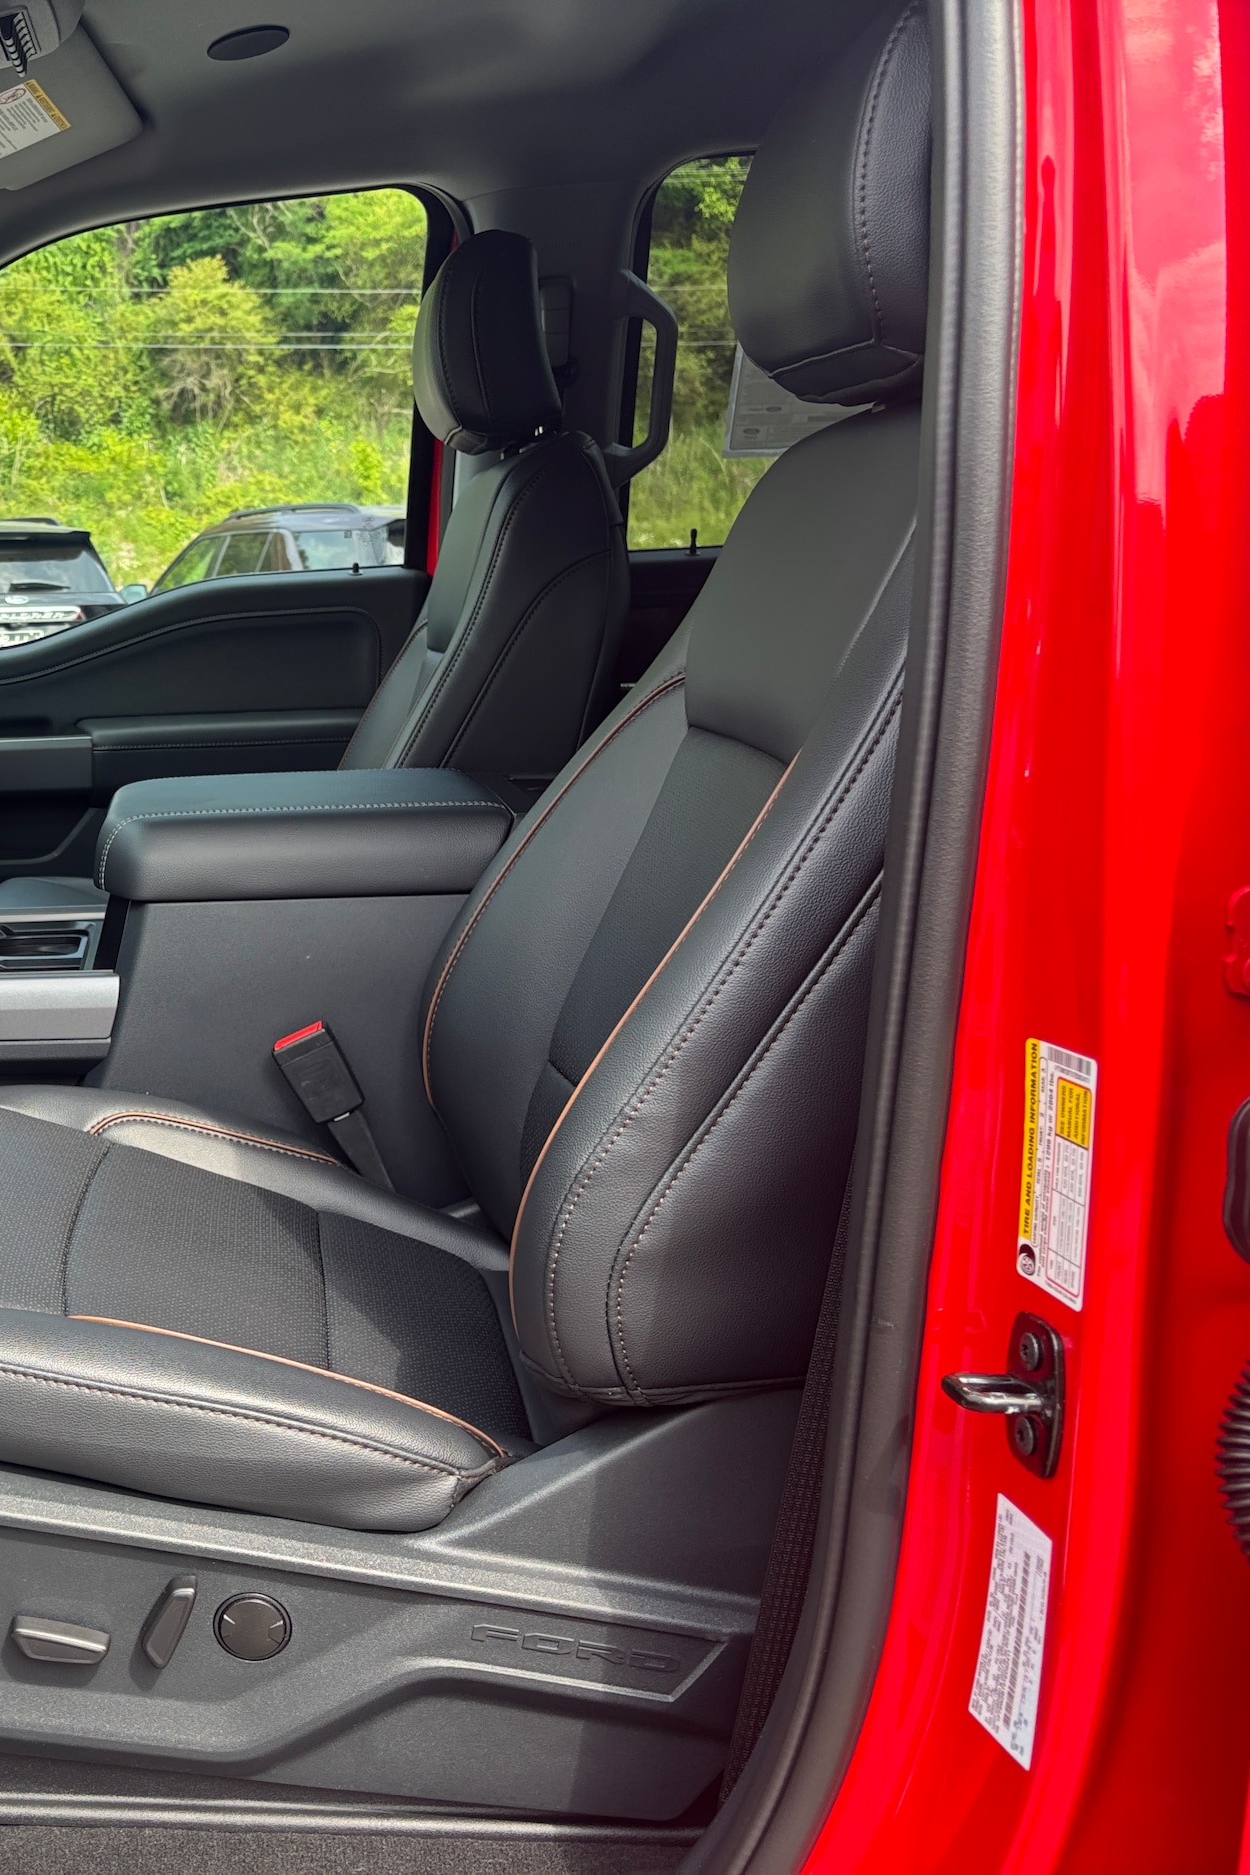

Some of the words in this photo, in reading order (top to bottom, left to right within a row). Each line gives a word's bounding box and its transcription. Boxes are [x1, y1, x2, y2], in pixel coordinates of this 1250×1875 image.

[1029, 1042, 1038, 1123] INFORMATION
[1026, 1127, 1035, 1178] LOADING
[1024, 1181, 1032, 1205] AND
[1023, 1209, 1031, 1235] TIRE
[471, 1623, 681, 1673] FORD
